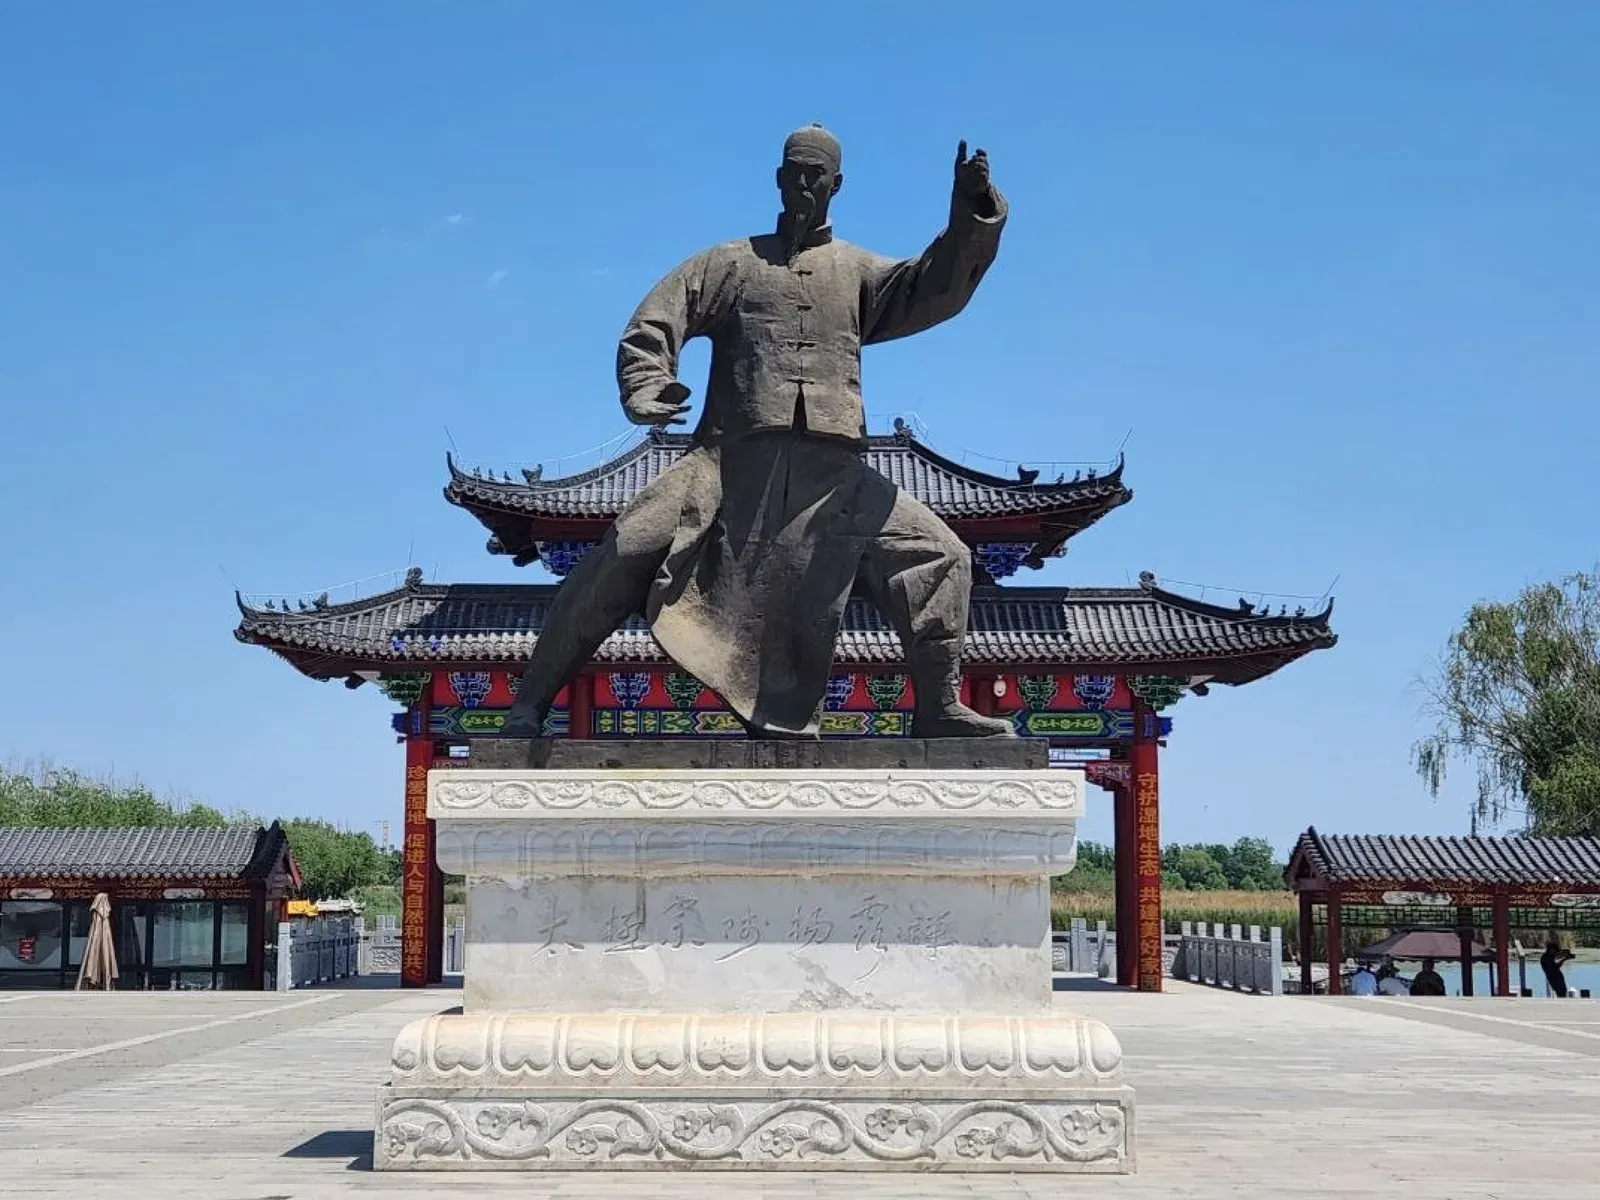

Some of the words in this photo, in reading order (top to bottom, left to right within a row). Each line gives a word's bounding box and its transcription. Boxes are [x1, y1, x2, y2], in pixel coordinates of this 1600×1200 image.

[408, 765, 427, 825] 珍爱湿地
[1138, 772, 1159, 876] 守护湿地生态
[1140, 886, 1160, 991] 共建美好家园
